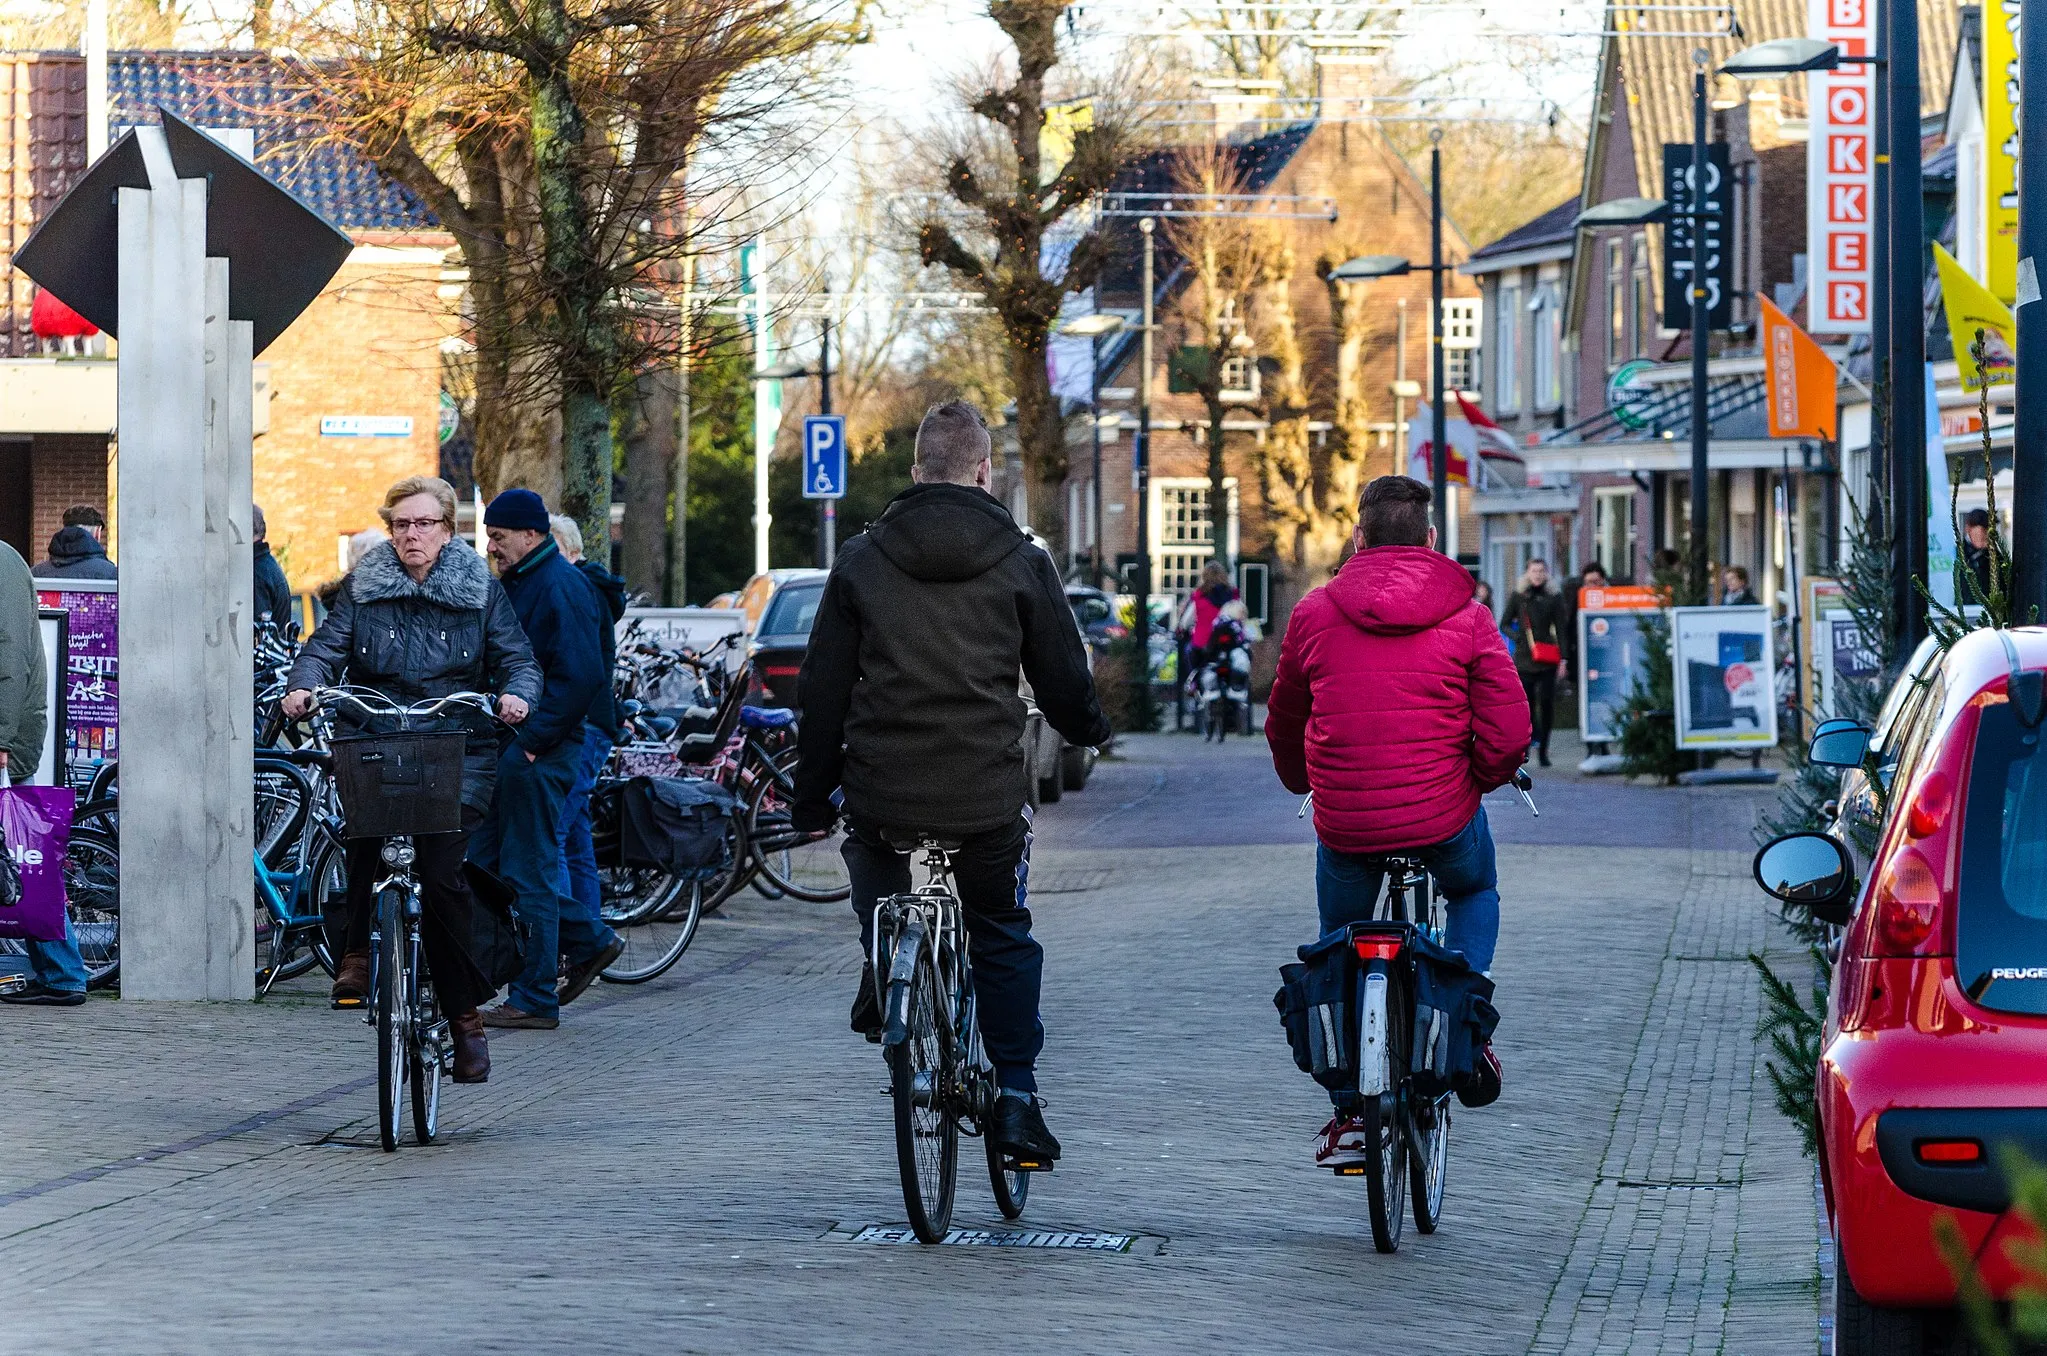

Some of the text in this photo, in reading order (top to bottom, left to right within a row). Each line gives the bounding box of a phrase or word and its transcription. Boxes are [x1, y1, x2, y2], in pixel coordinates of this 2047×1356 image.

[1829, 0, 1866, 318] BLOKKER
[1672, 167, 1685, 248] FASHION
[1776, 327, 1794, 425] BLOKKER
[811, 423, 835, 464] P
